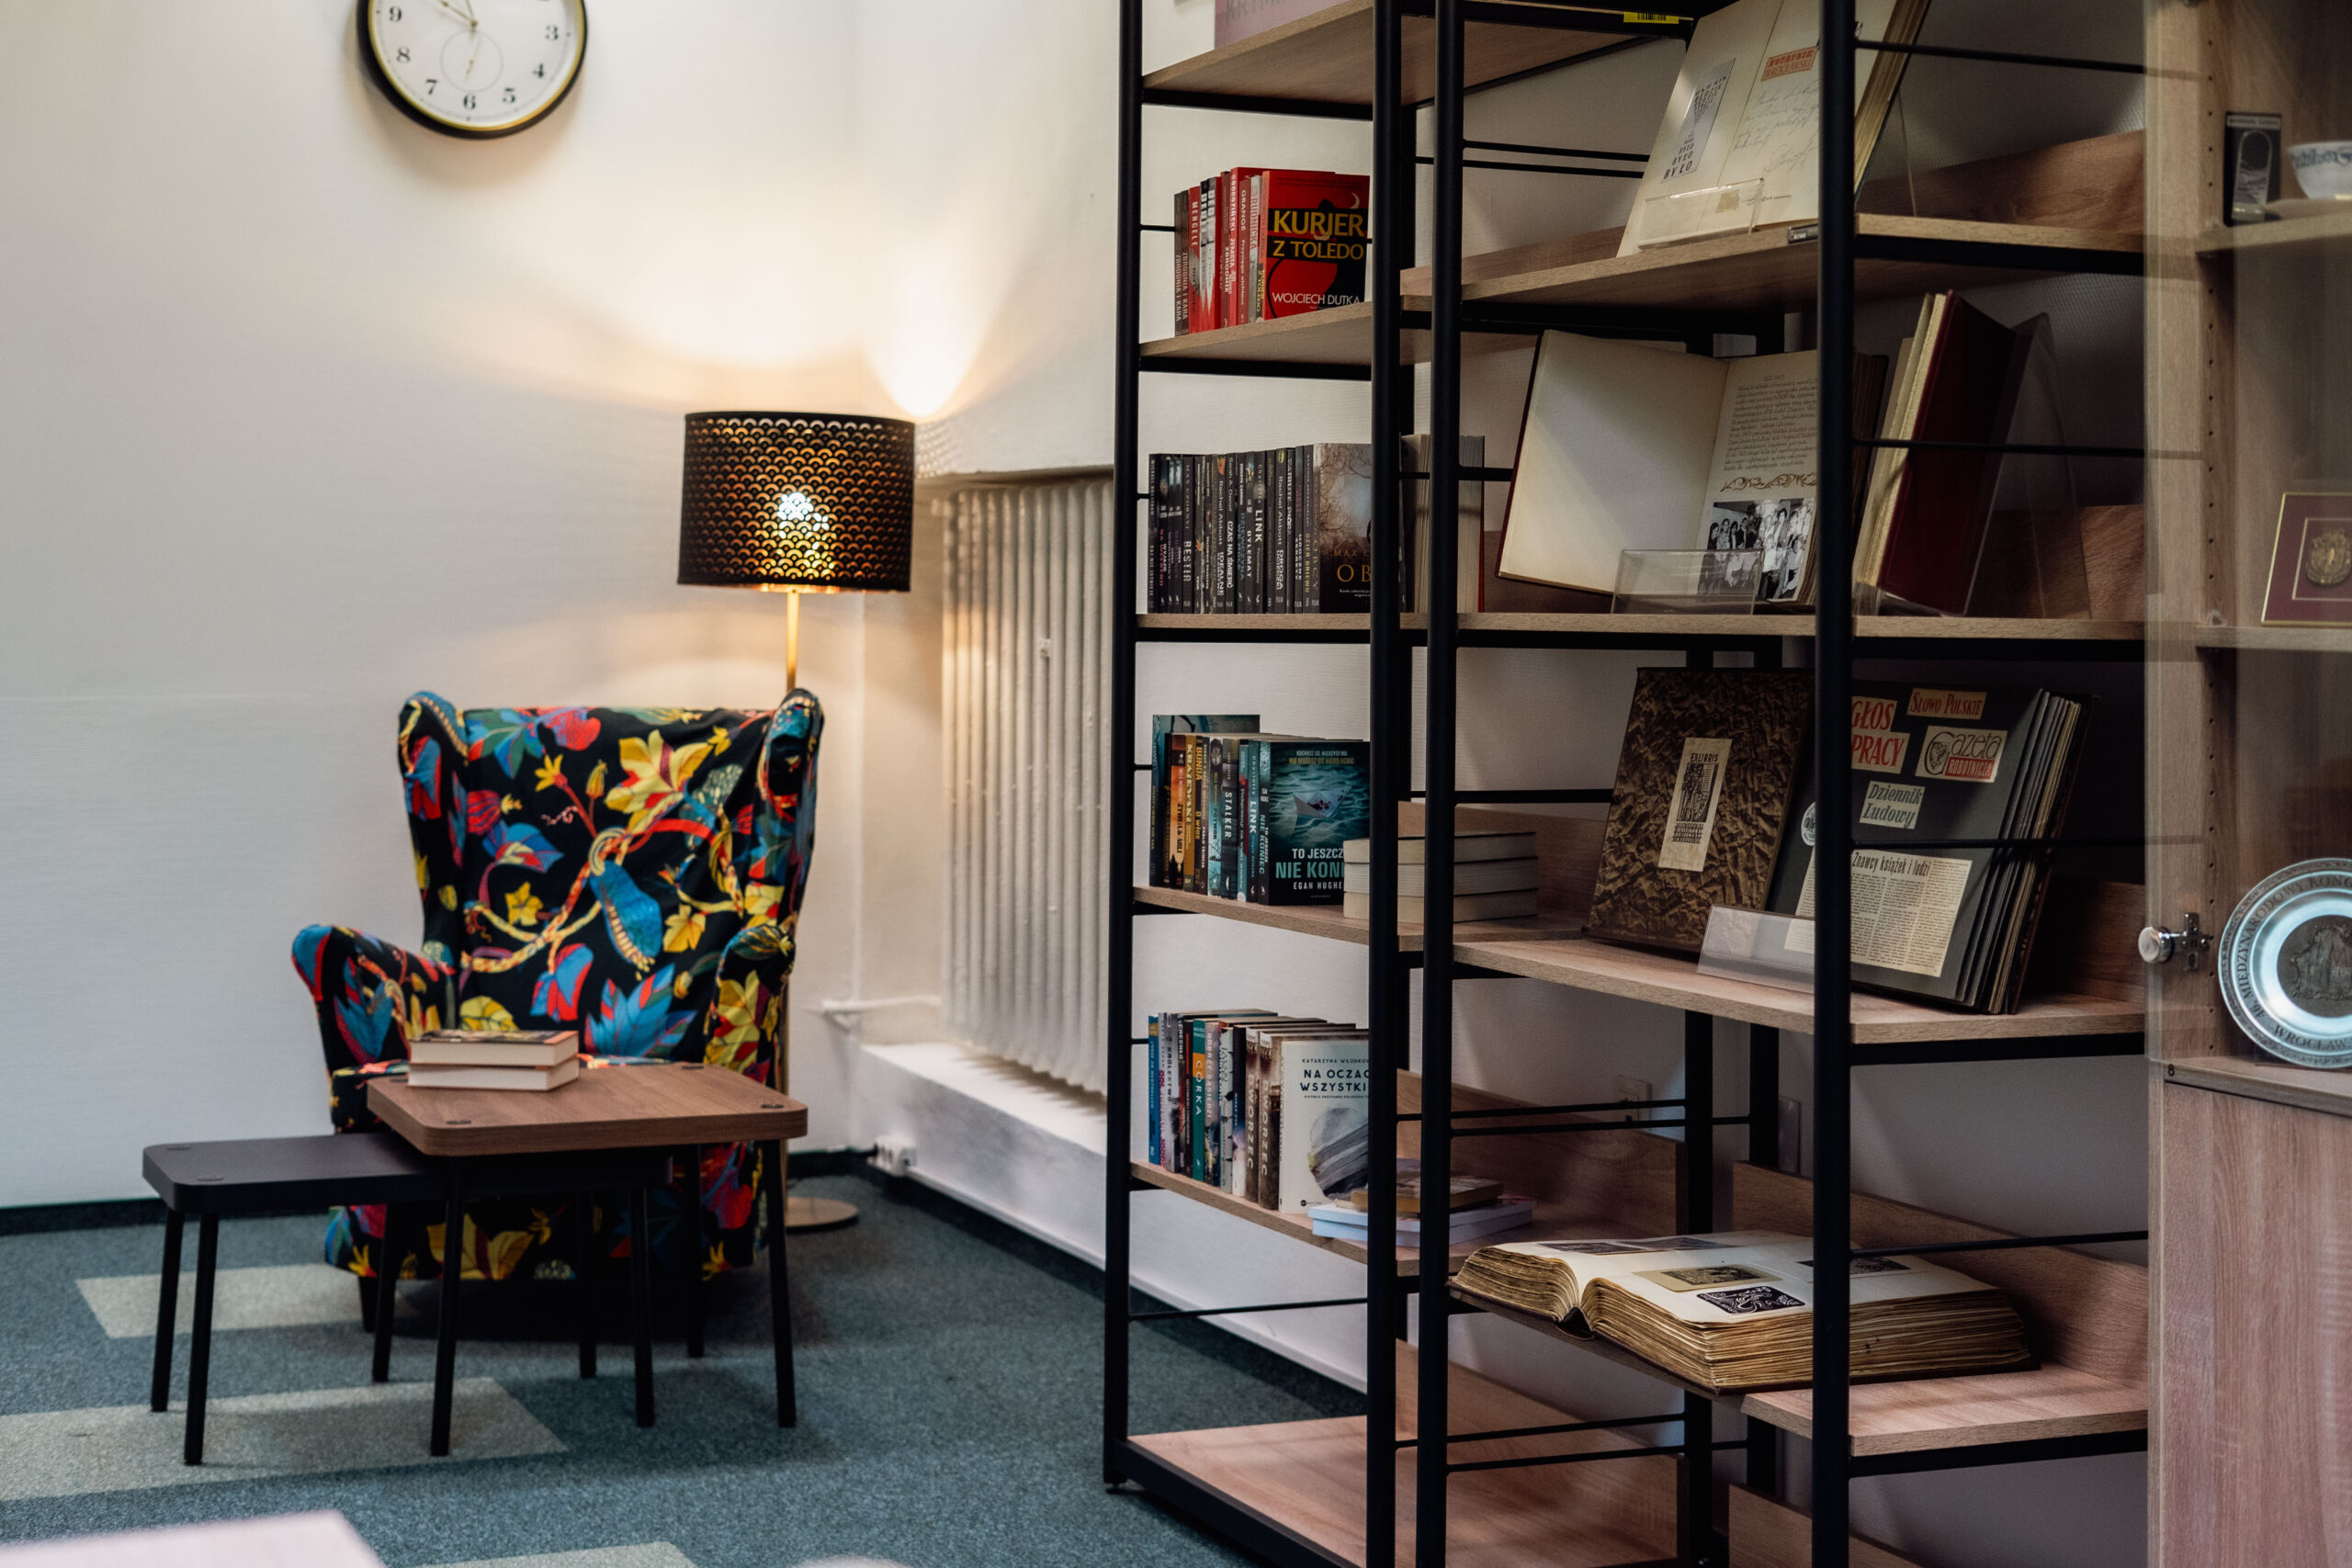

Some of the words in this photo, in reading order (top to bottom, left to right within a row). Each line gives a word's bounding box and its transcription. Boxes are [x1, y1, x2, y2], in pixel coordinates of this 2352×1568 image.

[390, 6, 402, 22] 9
[546, 25, 559, 40] 3
[397, 47, 411, 62] 8
[533, 63, 545, 78] 4
[425, 79, 437, 95] 7
[503, 87, 515, 103] 5
[464, 95, 476, 110] 6
[1250, 198, 1258, 250] RUDNICKA
[1272, 240, 1285, 257] Z
[1290, 241, 1364, 260] TOLEDO
[1272, 292, 1325, 305] WOJCIECH
[1328, 295, 1360, 306] DUTKA
[1159, 529, 1164, 541] NA
[1227, 544, 1232, 556] NA
[1851, 700, 1895, 730] GŁOS
[1851, 734, 1905, 767] PRACY
[1924, 731, 2002, 775] Gazeta
[1948, 759, 1992, 776] ROBOTNICZA
[1867, 784, 1922, 805] Dziennik
[1862, 803, 1916, 829] Ludowy
[1292, 848, 1306, 859] TO
[1275, 862, 1302, 879] NIE
[1852, 852, 1879, 873] Znawcy
[1880, 856, 1906, 875] książek
[1913, 860, 1931, 876] ludzi
[1293, 882, 1314, 890] EGAN
[1317, 881, 1342, 889] HUGHE
[2274, 1023, 2346, 1050] WROCŁAW
[1304, 1069, 1321, 1078] NA
[1300, 1082, 1366, 1091] WSZYSTKI
